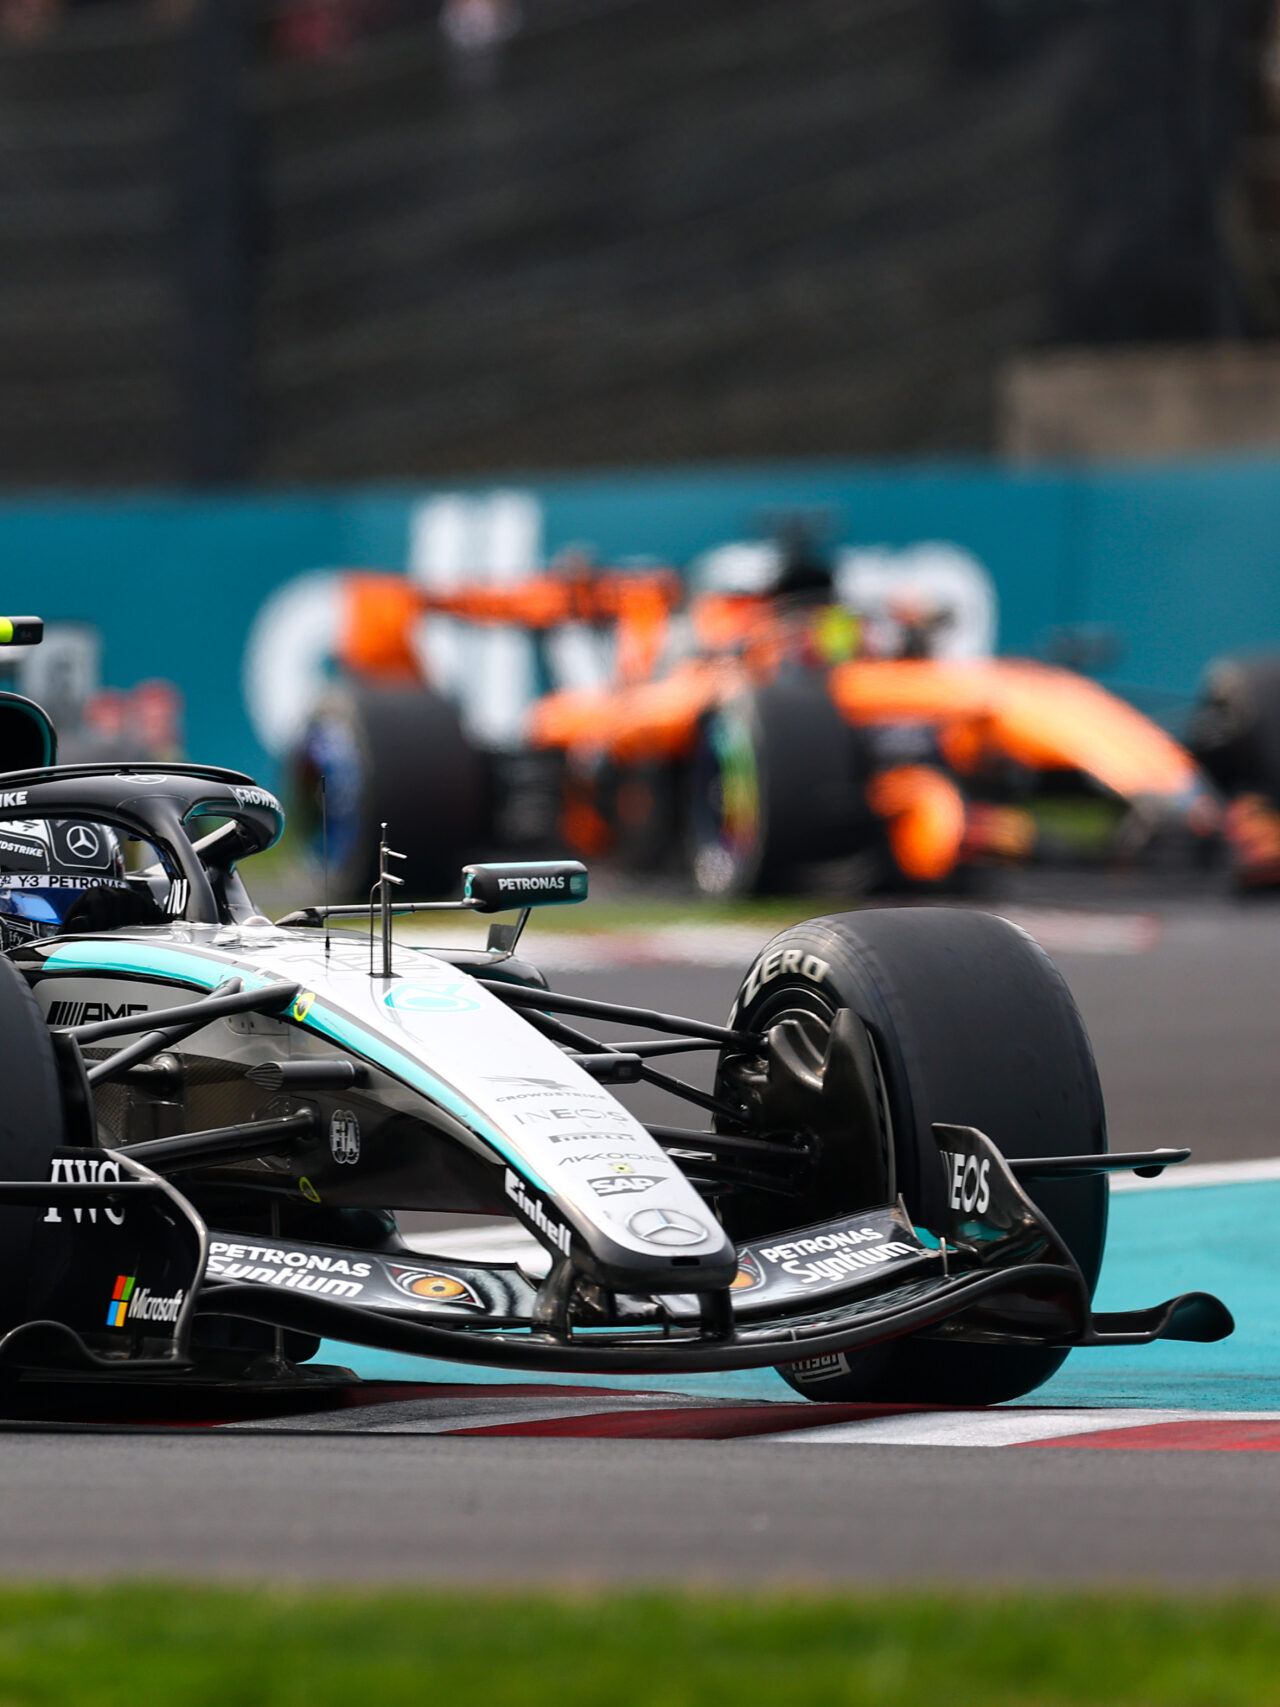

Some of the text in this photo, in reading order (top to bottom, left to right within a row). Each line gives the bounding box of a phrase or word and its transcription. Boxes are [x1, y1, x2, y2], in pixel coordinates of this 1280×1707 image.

[497, 877, 566, 891] PETRONAS
[742, 949, 832, 1009] ZERO
[513, 1108, 629, 1126] INEOS
[590, 1177, 656, 1195] SAP
[504, 1167, 572, 1257] Einhell
[210, 1242, 372, 1279] PETRONAS
[759, 1226, 884, 1264] PETRONAS
[780, 1240, 919, 1284] Syntium
[206, 1255, 365, 1298] Syntium
[128, 1287, 183, 1322] Microsoft
